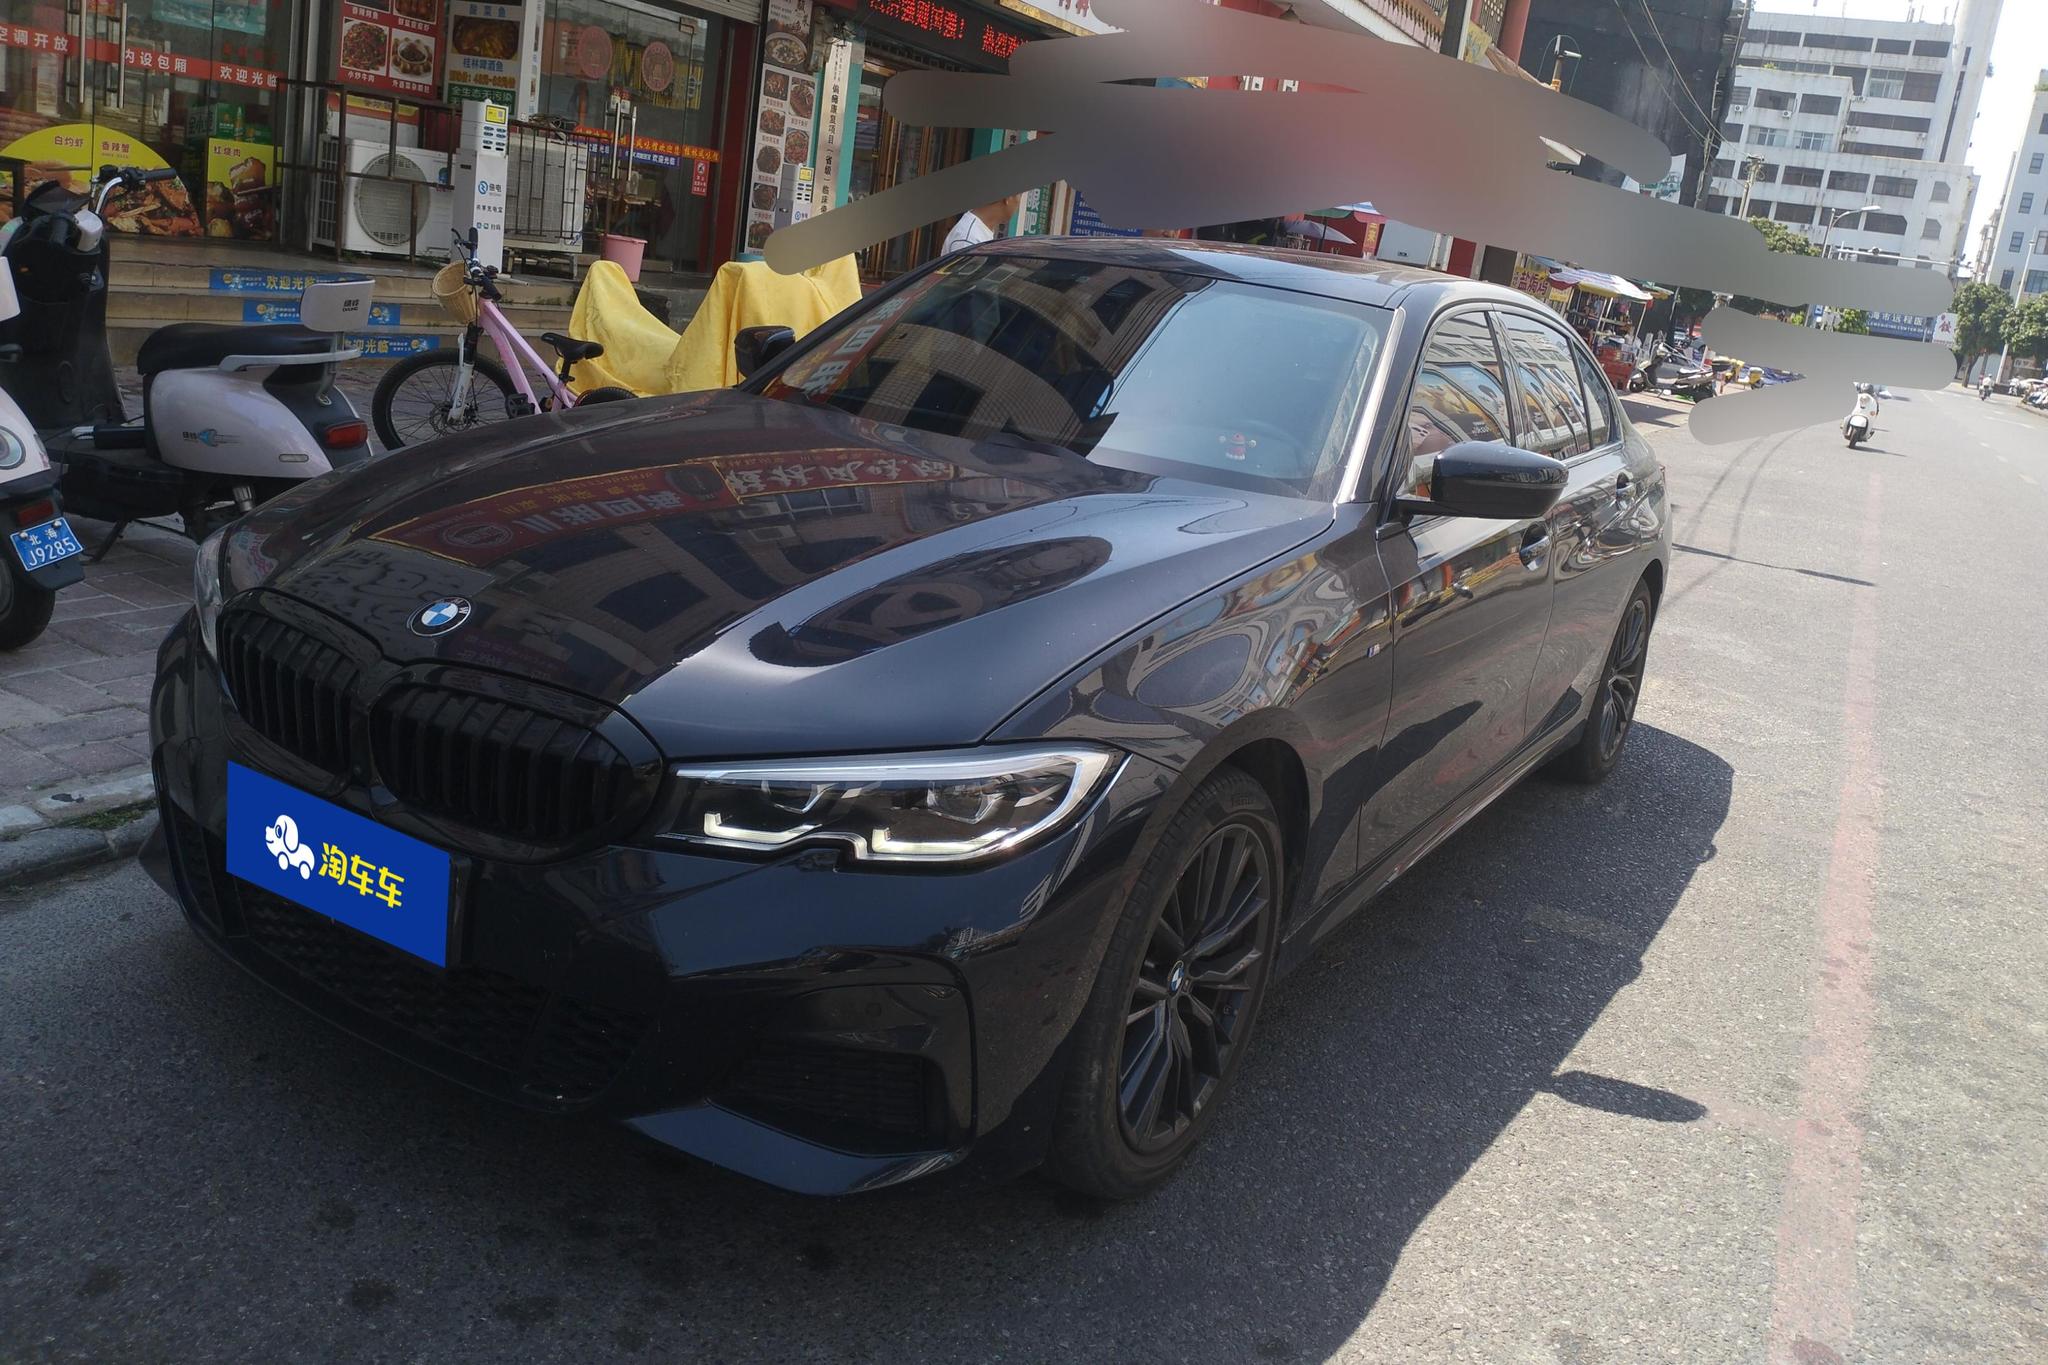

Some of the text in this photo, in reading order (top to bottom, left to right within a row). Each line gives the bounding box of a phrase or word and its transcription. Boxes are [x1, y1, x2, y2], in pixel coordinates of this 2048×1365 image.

[0, 25, 69, 52] 空调开放
[220, 65, 279, 88] 欢迎光临
[101, 141, 130, 154] 香辣蟹
[213, 145, 241, 157] 红烧肉
[29, 527, 58, 546] 北海
[29, 536, 77, 567] J9285
